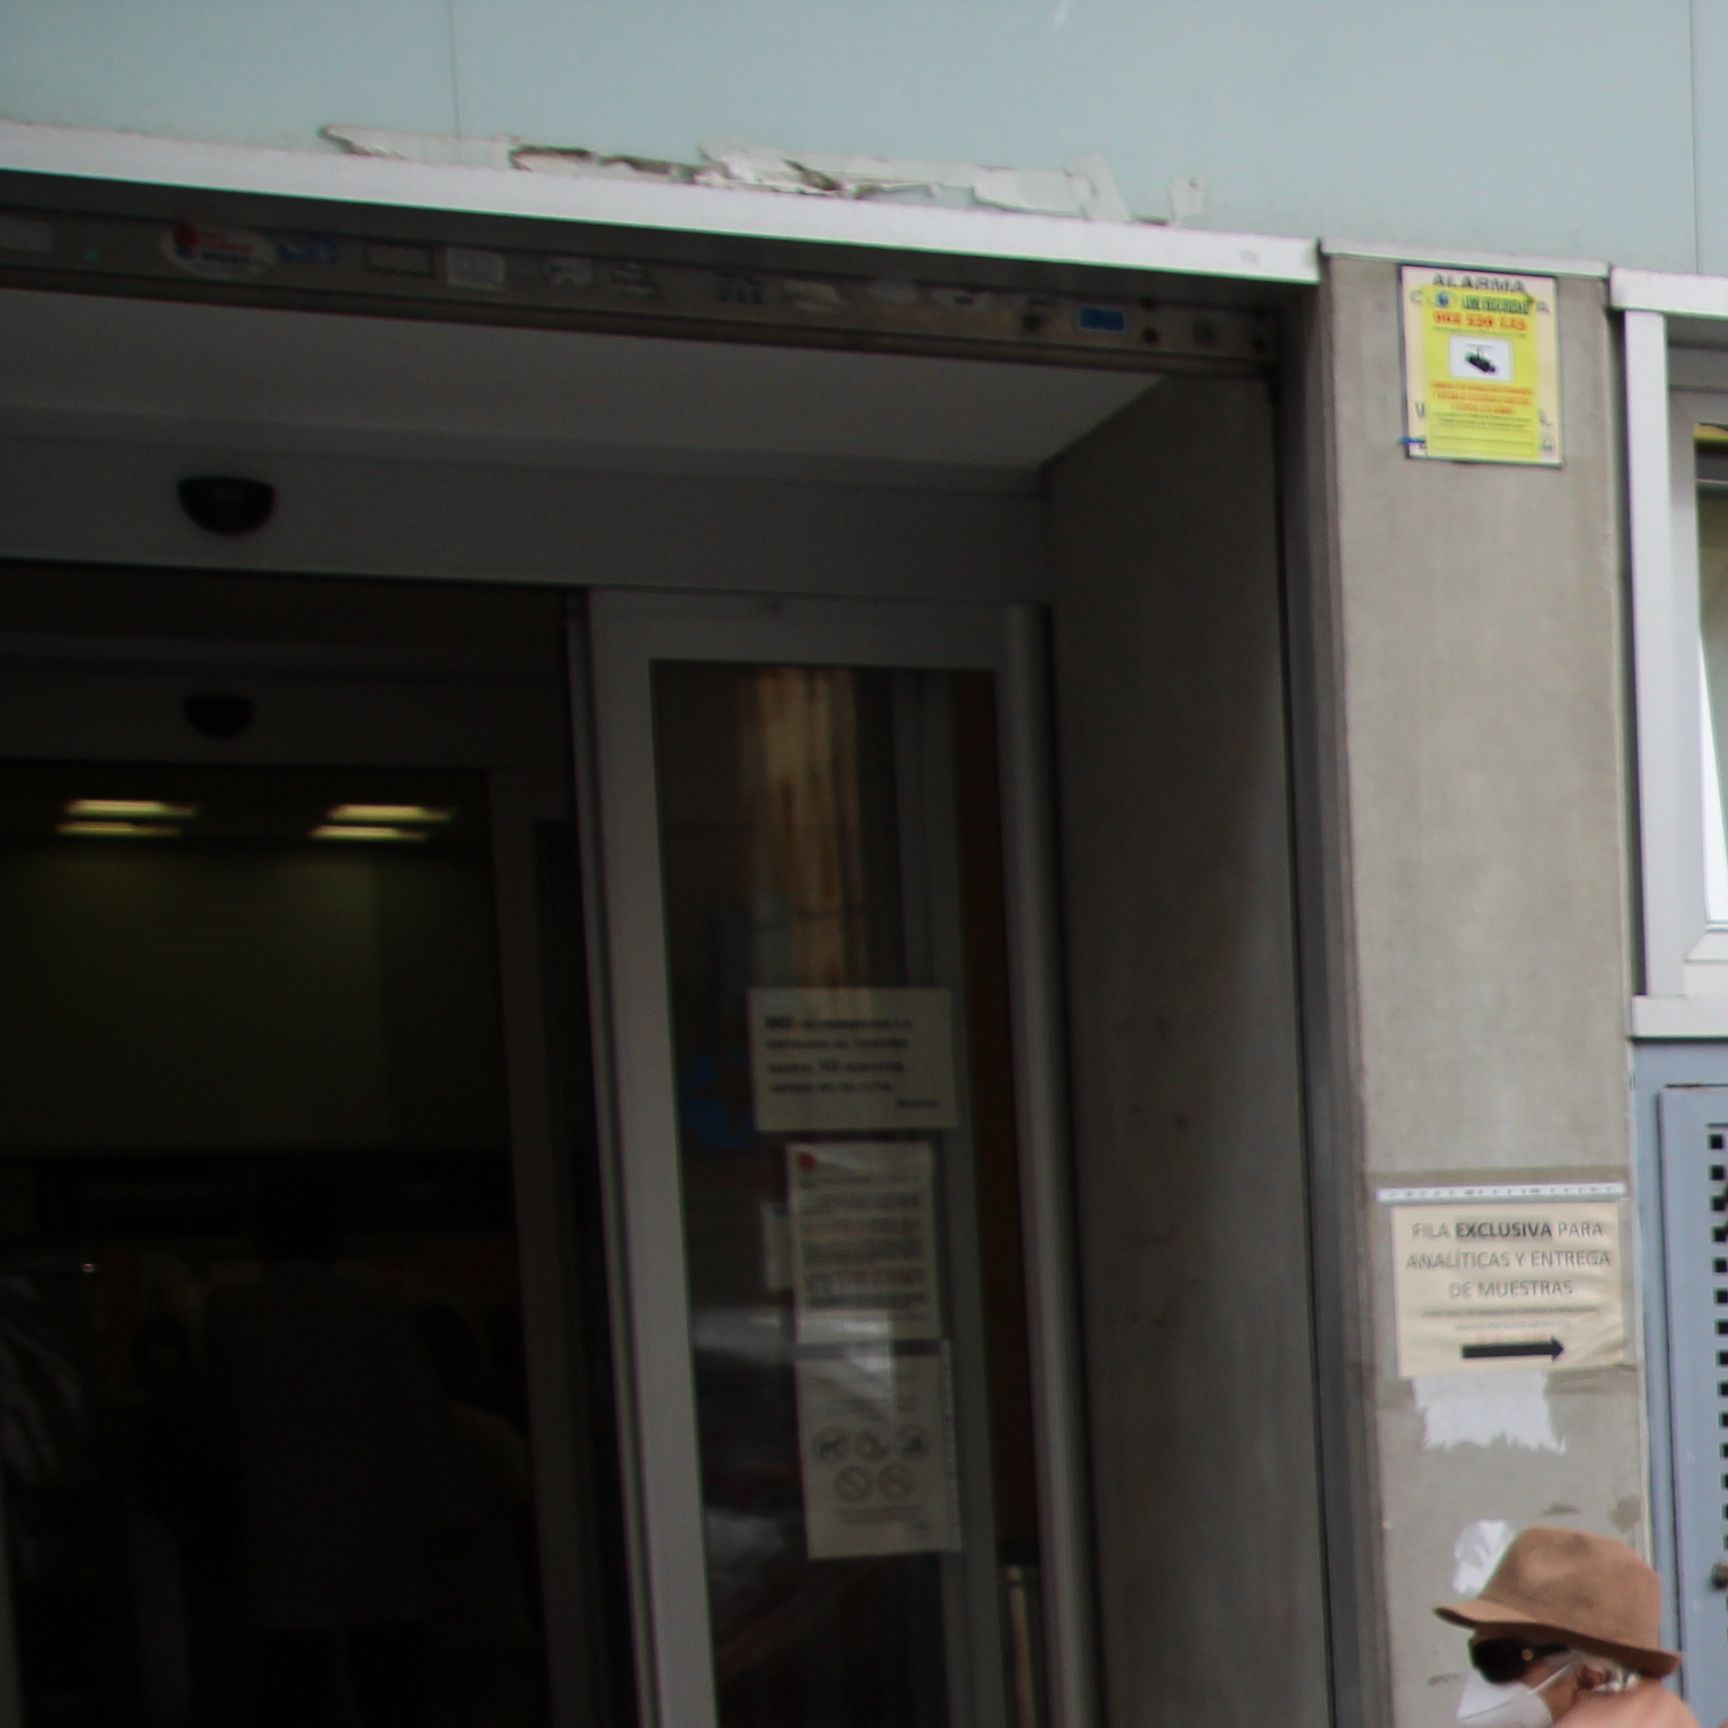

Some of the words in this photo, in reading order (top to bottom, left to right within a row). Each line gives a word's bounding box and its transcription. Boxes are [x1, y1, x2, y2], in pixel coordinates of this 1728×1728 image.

[1413, 1223, 1449, 1239] FILA
[1455, 1222, 1553, 1238] EXCLUSIVA
[1558, 1221, 1603, 1237] PARA
[1515, 1252, 1525, 1267] Y
[1531, 1250, 1611, 1266] ENTREGA
[1451, 1282, 1472, 1297] DE
[1477, 1280, 1573, 1297] MUESTRAS
